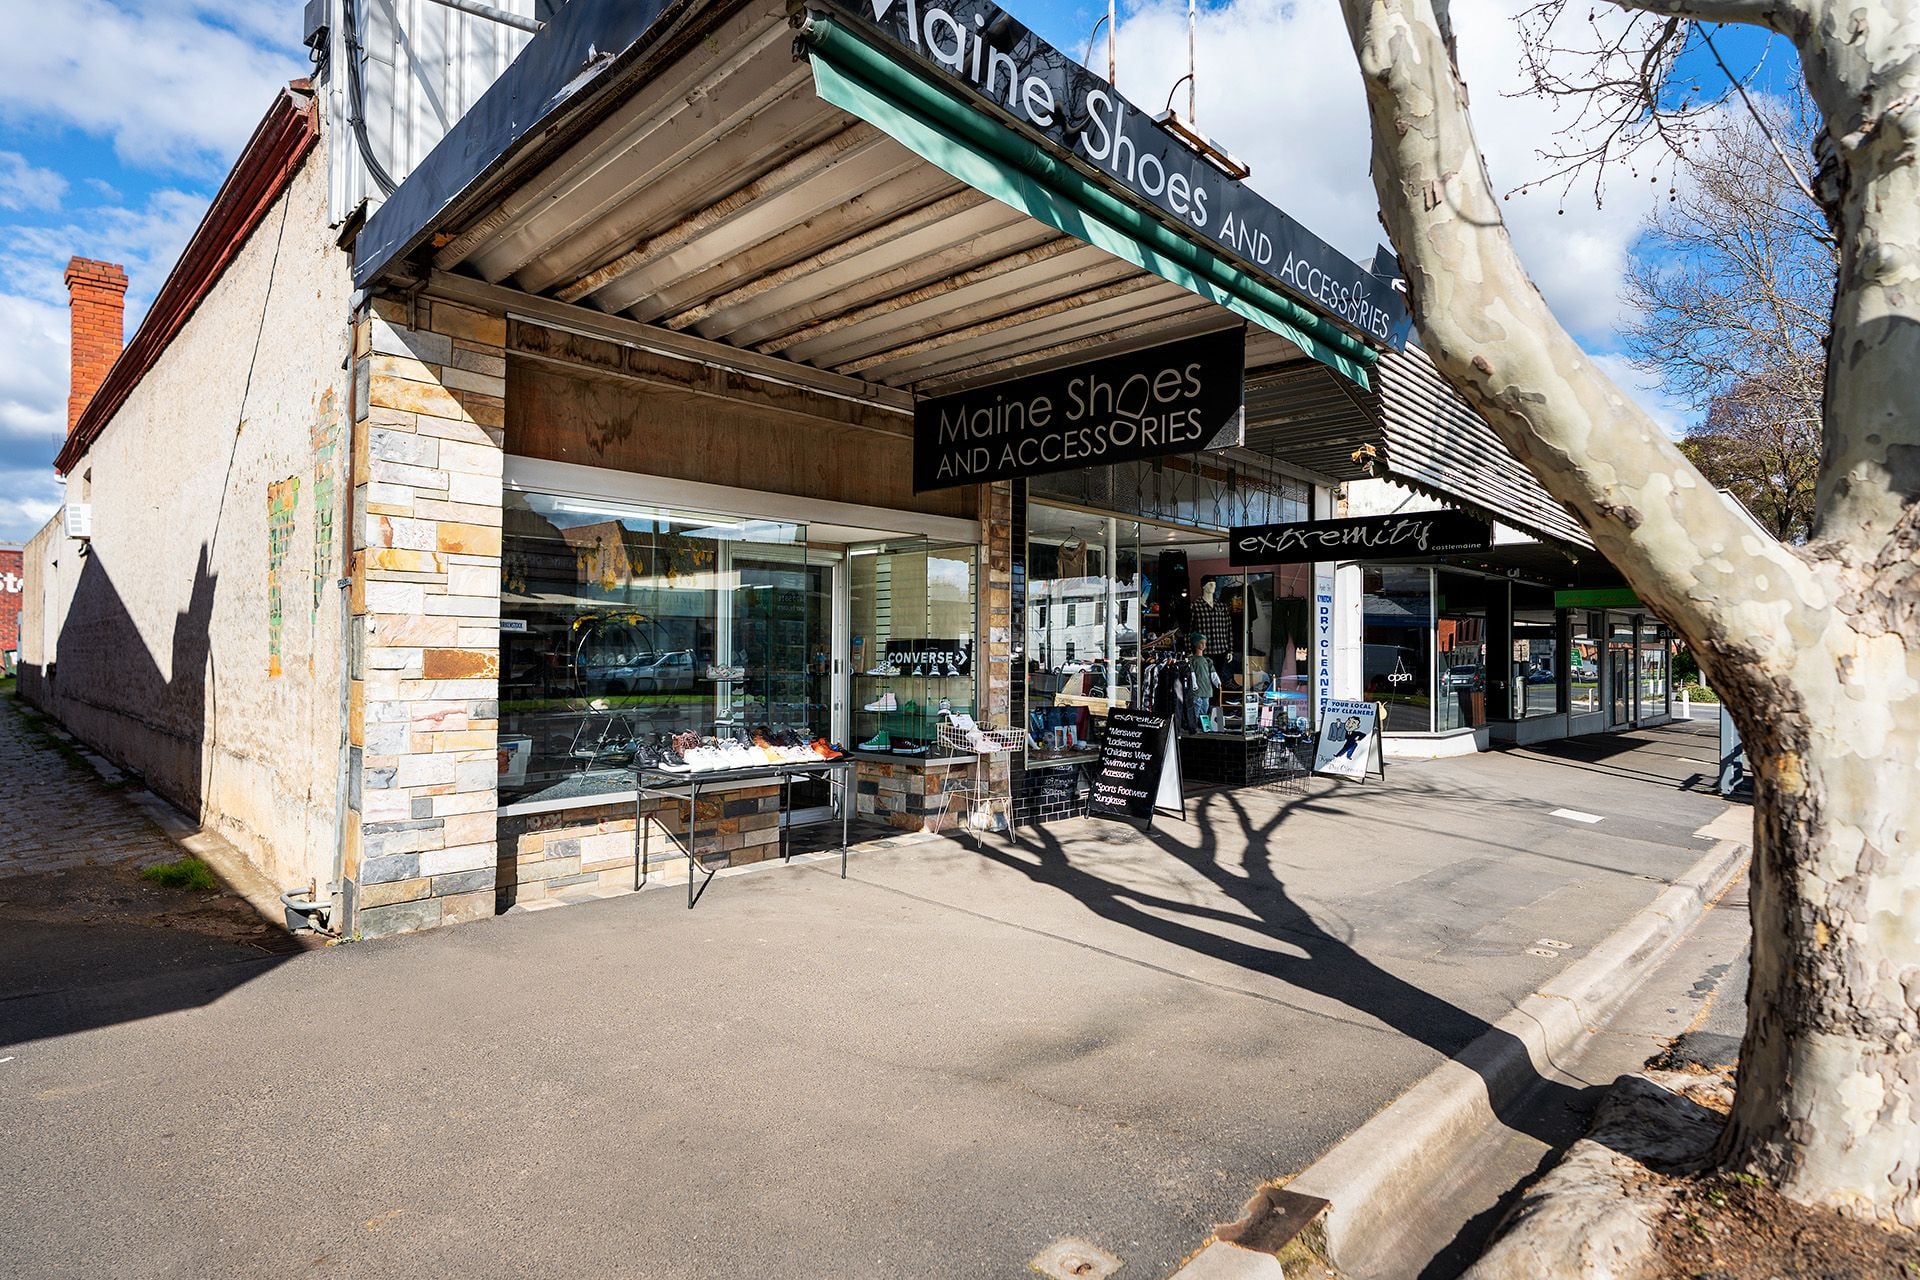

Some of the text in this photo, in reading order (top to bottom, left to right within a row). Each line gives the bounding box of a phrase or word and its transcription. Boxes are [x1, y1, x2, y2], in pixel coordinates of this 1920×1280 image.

[1080, 89, 1208, 227] Shoes
[1218, 211, 1273, 265] AND
[1280, 251, 1390, 339] ACCESSORIES
[938, 363, 1201, 445] Maine Shoes
[936, 408, 1202, 480] AND ACCESSORIES
[1239, 519, 1433, 553] extremity
[1431, 543, 1482, 551] castlemaine
[1320, 606, 1329, 634] DRY
[887, 651, 954, 665] CONVERSE
[1388, 673, 1412, 687] open
[1342, 708, 1375, 716] CLEANERS
[1114, 714, 1165, 728] extremity
[1134, 751, 1152, 761] Wear
[1139, 762, 1145, 770] &
[1101, 767, 1135, 780] Accessories
[1117, 785, 1149, 799] Footwear
